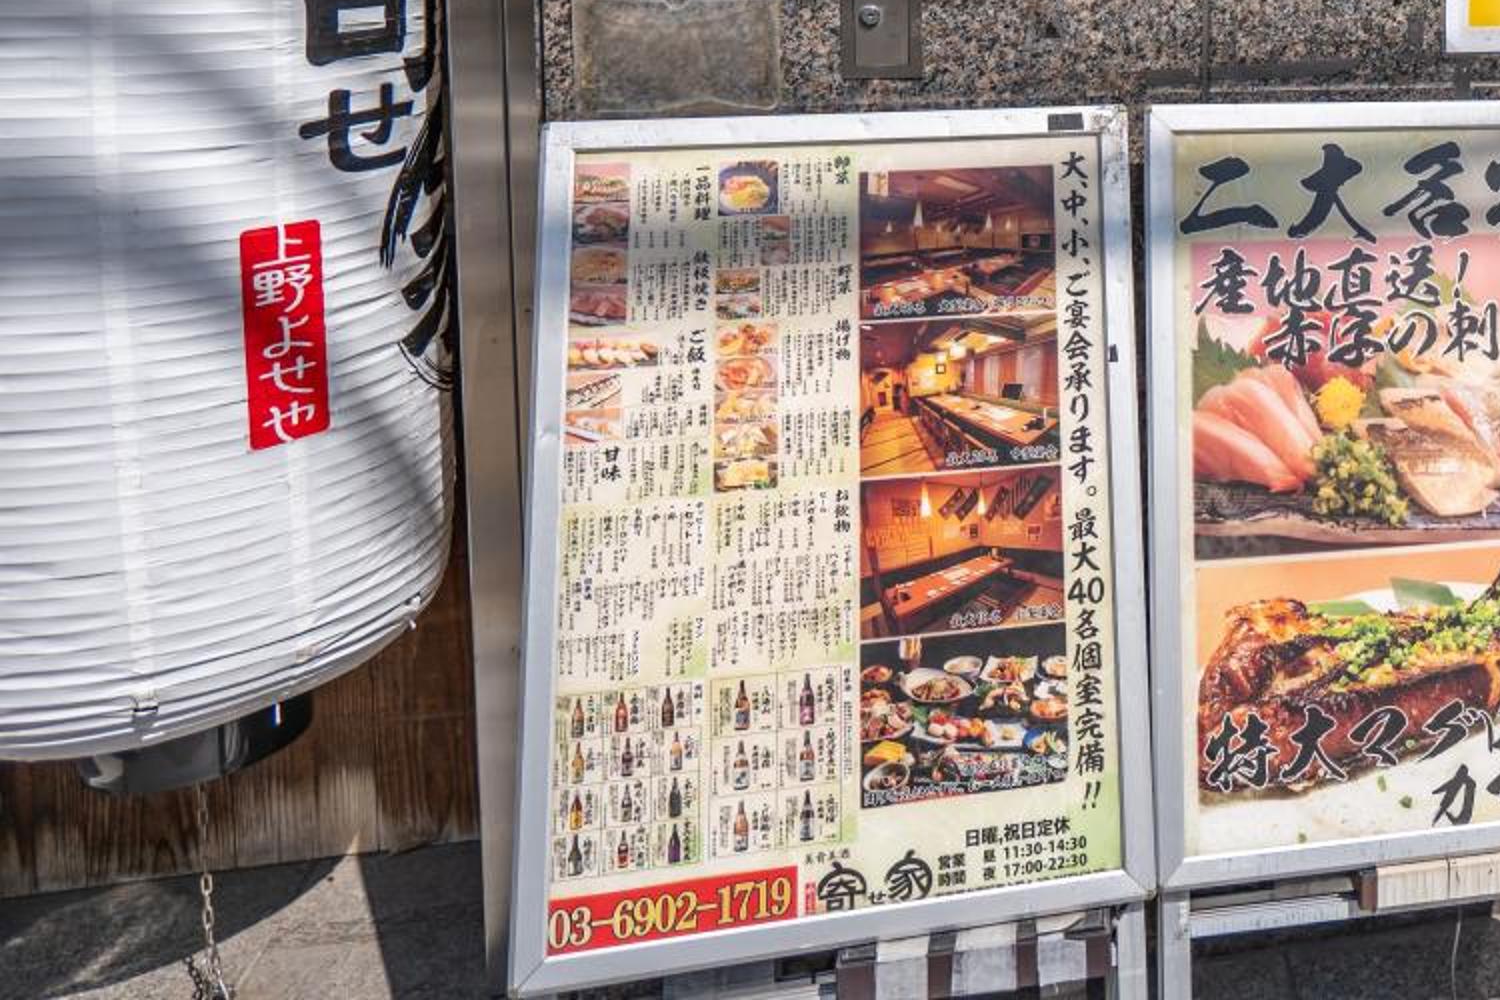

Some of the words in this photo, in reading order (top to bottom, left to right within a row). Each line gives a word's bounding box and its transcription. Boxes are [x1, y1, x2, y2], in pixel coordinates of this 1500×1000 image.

[1194, 246, 1469, 316] 産地直送!
[251, 226, 318, 443] 上野よせや
[601, 446, 621, 482] 甘味
[1004, 835, 1087, 860] 11:30-14:30
[1004, 853, 1087, 878] 17:00-22:30
[548, 877, 793, 950] 03-6902-1719
